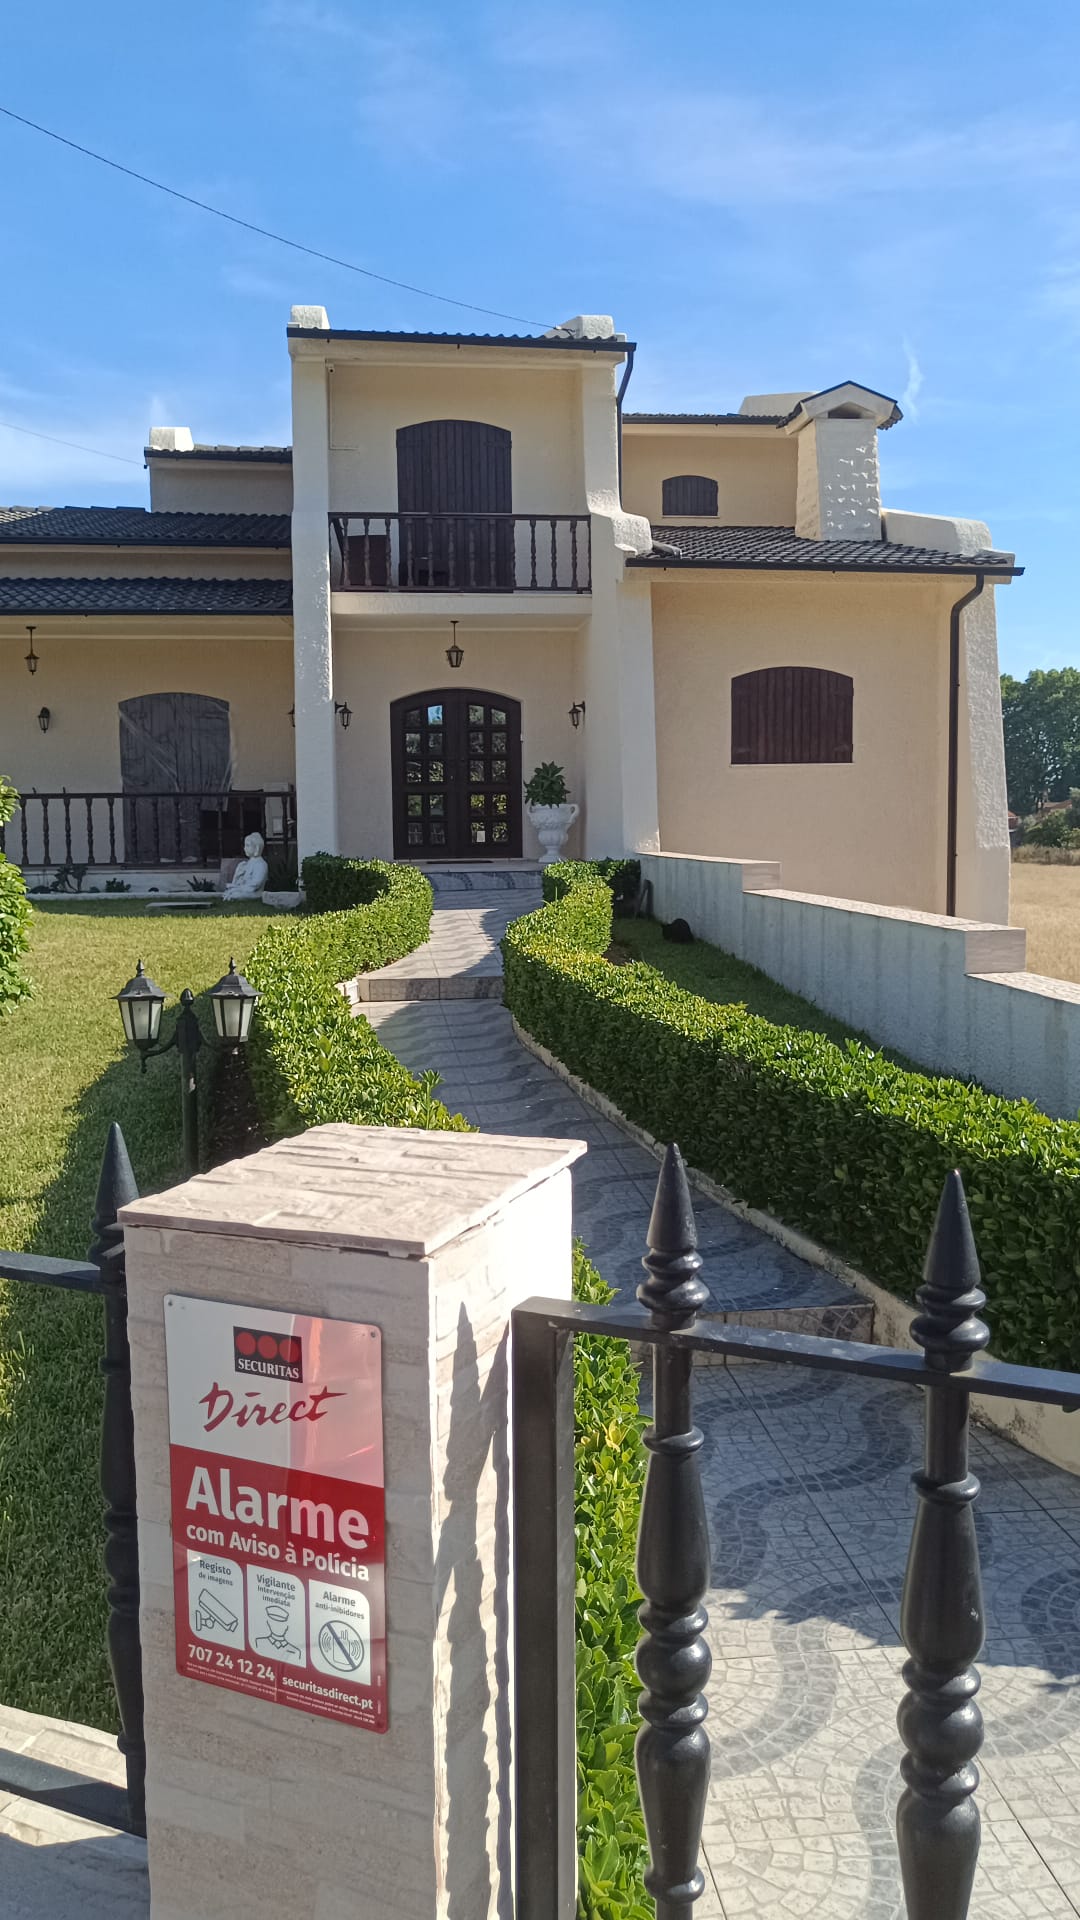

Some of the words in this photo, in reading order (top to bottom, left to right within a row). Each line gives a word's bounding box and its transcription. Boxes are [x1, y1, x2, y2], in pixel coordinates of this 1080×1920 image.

[238, 1358, 299, 1379] SECURITAS
[199, 1382, 348, 1432] Direct
[185, 1465, 369, 1550] Alarme
[186, 1525, 224, 1546] com
[229, 1531, 280, 1559] Aviso
[284, 1541, 297, 1564] à
[302, 1548, 369, 1581] Polícia
[199, 1560, 232, 1576] Registo
[198, 1571, 206, 1580] de
[207, 1573, 234, 1587] imagens
[256, 1573, 296, 1592] Vigilante
[257, 1585, 296, 1601] Intervenção
[262, 1594, 291, 1608] imediata
[322, 1590, 356, 1607] Alarme
[314, 1601, 365, 1620] anti-inibidores
[188, 1644, 213, 1663] 707
[216, 1652, 234, 1669] 24
[237, 1658, 254, 1675] 12
[256, 1663, 275, 1681] 24
[282, 1675, 374, 1711] securitasdirect.pt
